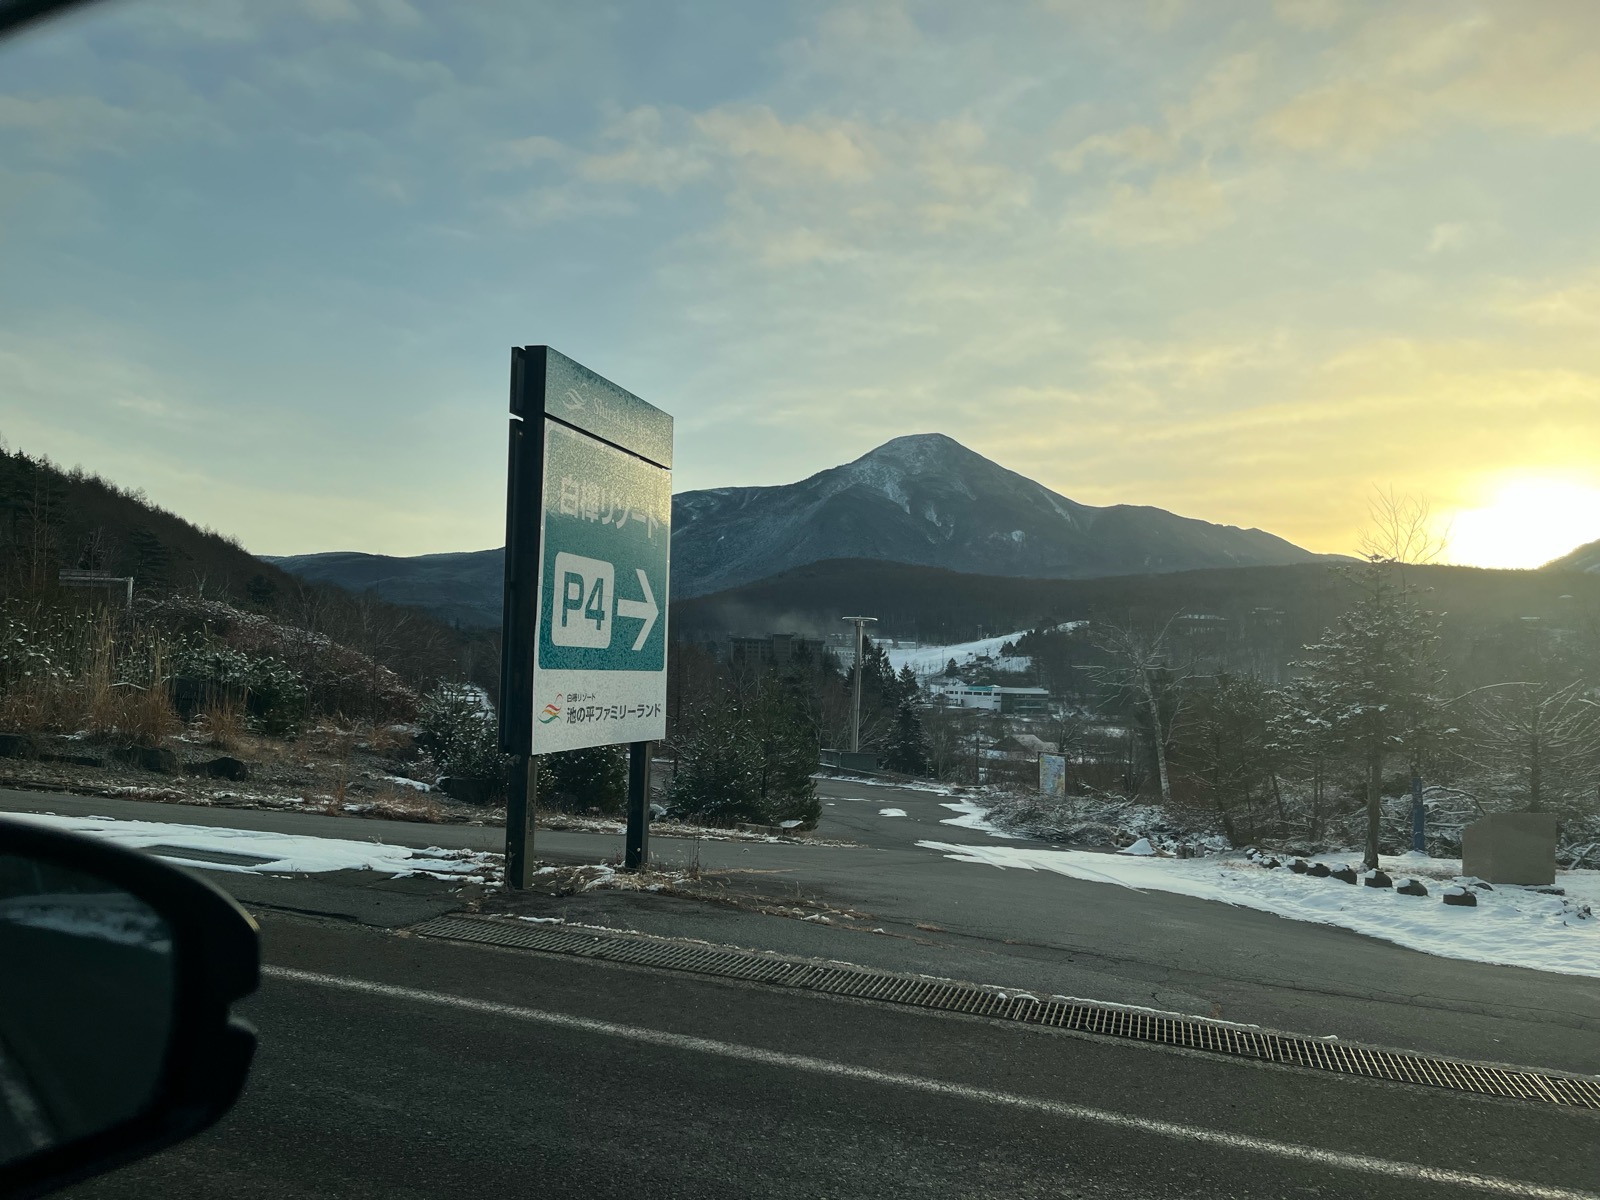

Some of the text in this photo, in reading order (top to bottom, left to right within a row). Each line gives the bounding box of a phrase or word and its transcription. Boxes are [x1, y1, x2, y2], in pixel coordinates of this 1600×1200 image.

[562, 571, 605, 631] P4
[566, 703, 662, 724] 池の平ファミリーランド
